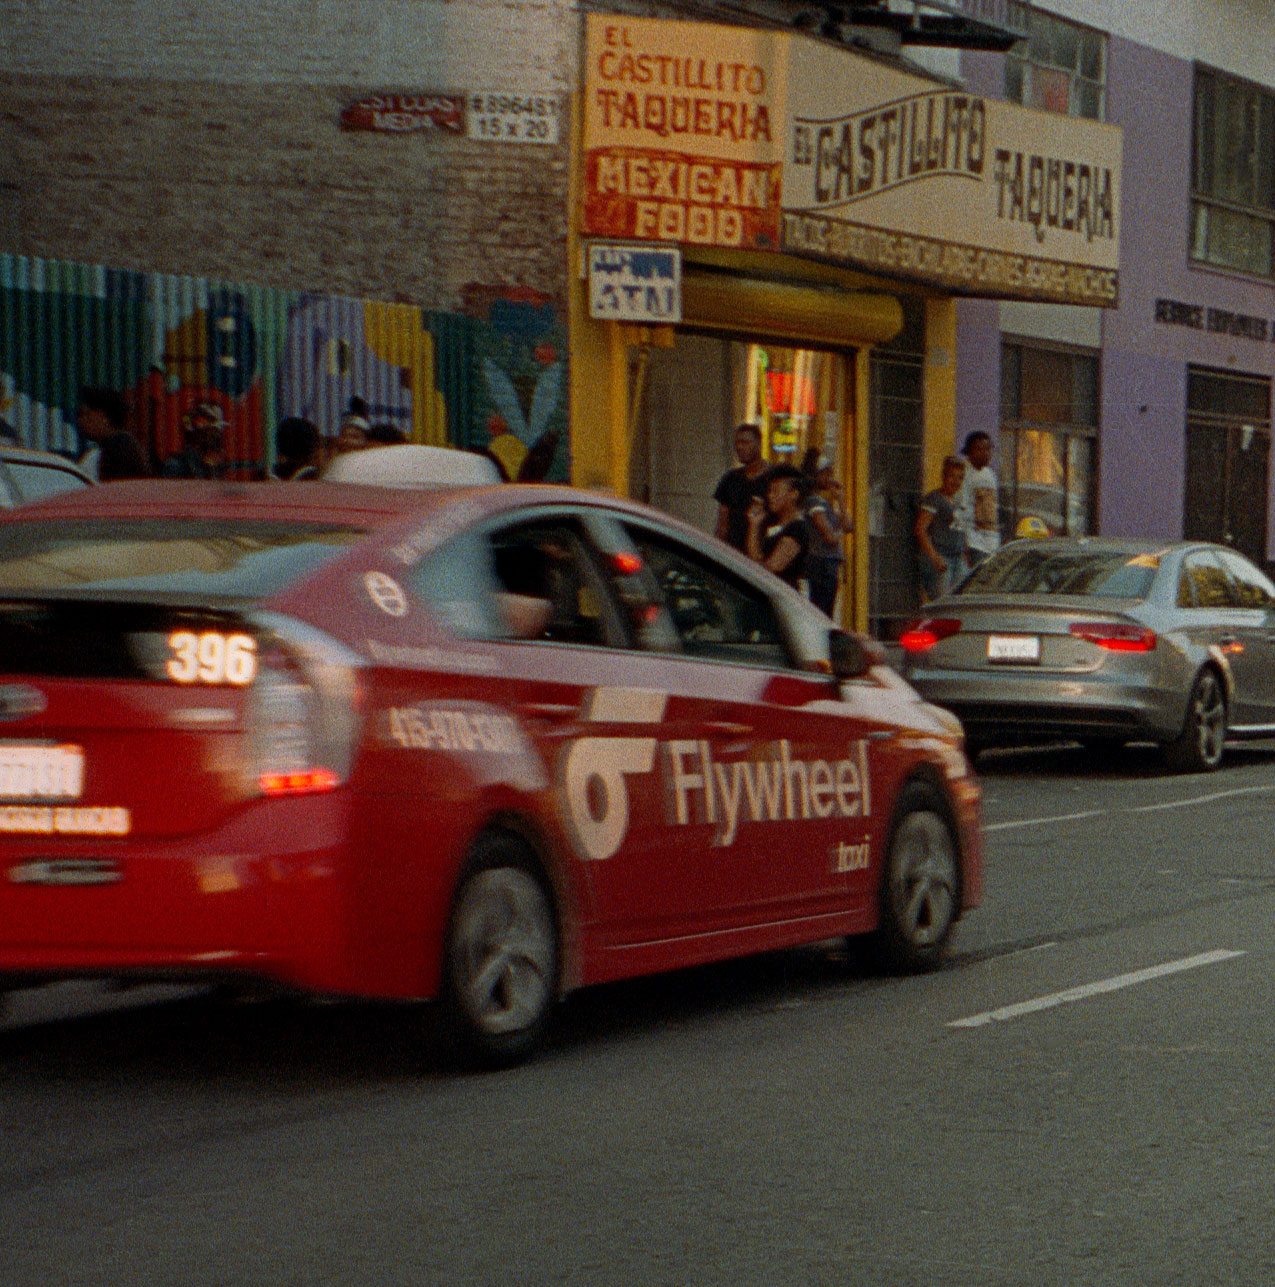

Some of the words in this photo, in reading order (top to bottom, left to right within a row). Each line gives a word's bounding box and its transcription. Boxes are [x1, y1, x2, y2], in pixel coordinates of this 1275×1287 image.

[605, 25, 633, 47] EL
[599, 51, 765, 95] CASTILLITO
[479, 116, 501, 135] 15
[526, 118, 549, 138] 20
[597, 87, 772, 143] TAQUERIA
[815, 97, 986, 203] CASTILLITO
[597, 155, 769, 208] MEXICAN
[995, 148, 1113, 243] TAQUERIA
[635, 201, 744, 245] FOOD
[169, 631, 257, 683] 396
[668, 739, 870, 846] Flywheel
[834, 834, 870, 873] taxi
